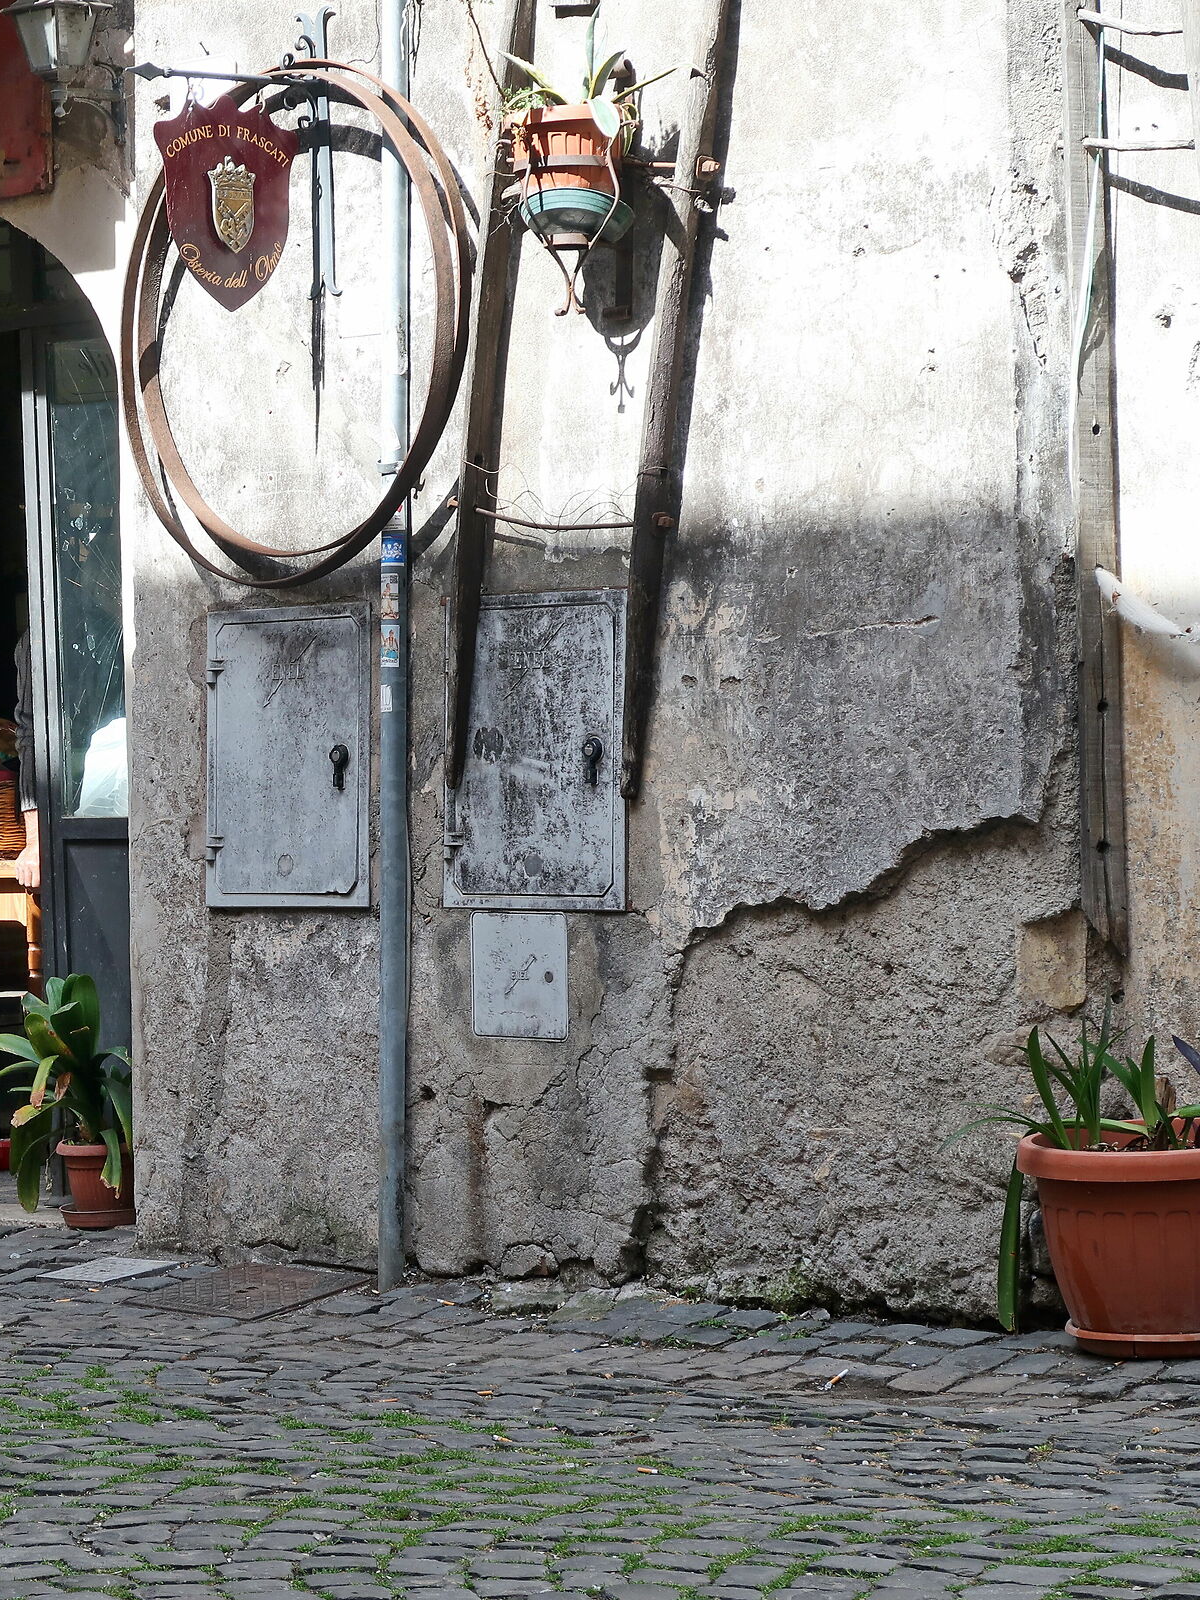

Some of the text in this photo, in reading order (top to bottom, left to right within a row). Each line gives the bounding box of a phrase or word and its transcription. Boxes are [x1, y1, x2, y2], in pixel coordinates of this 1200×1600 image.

[166, 124, 289, 168] COMUNE DI FRASCATI
[180, 243, 222, 286] Osteria
